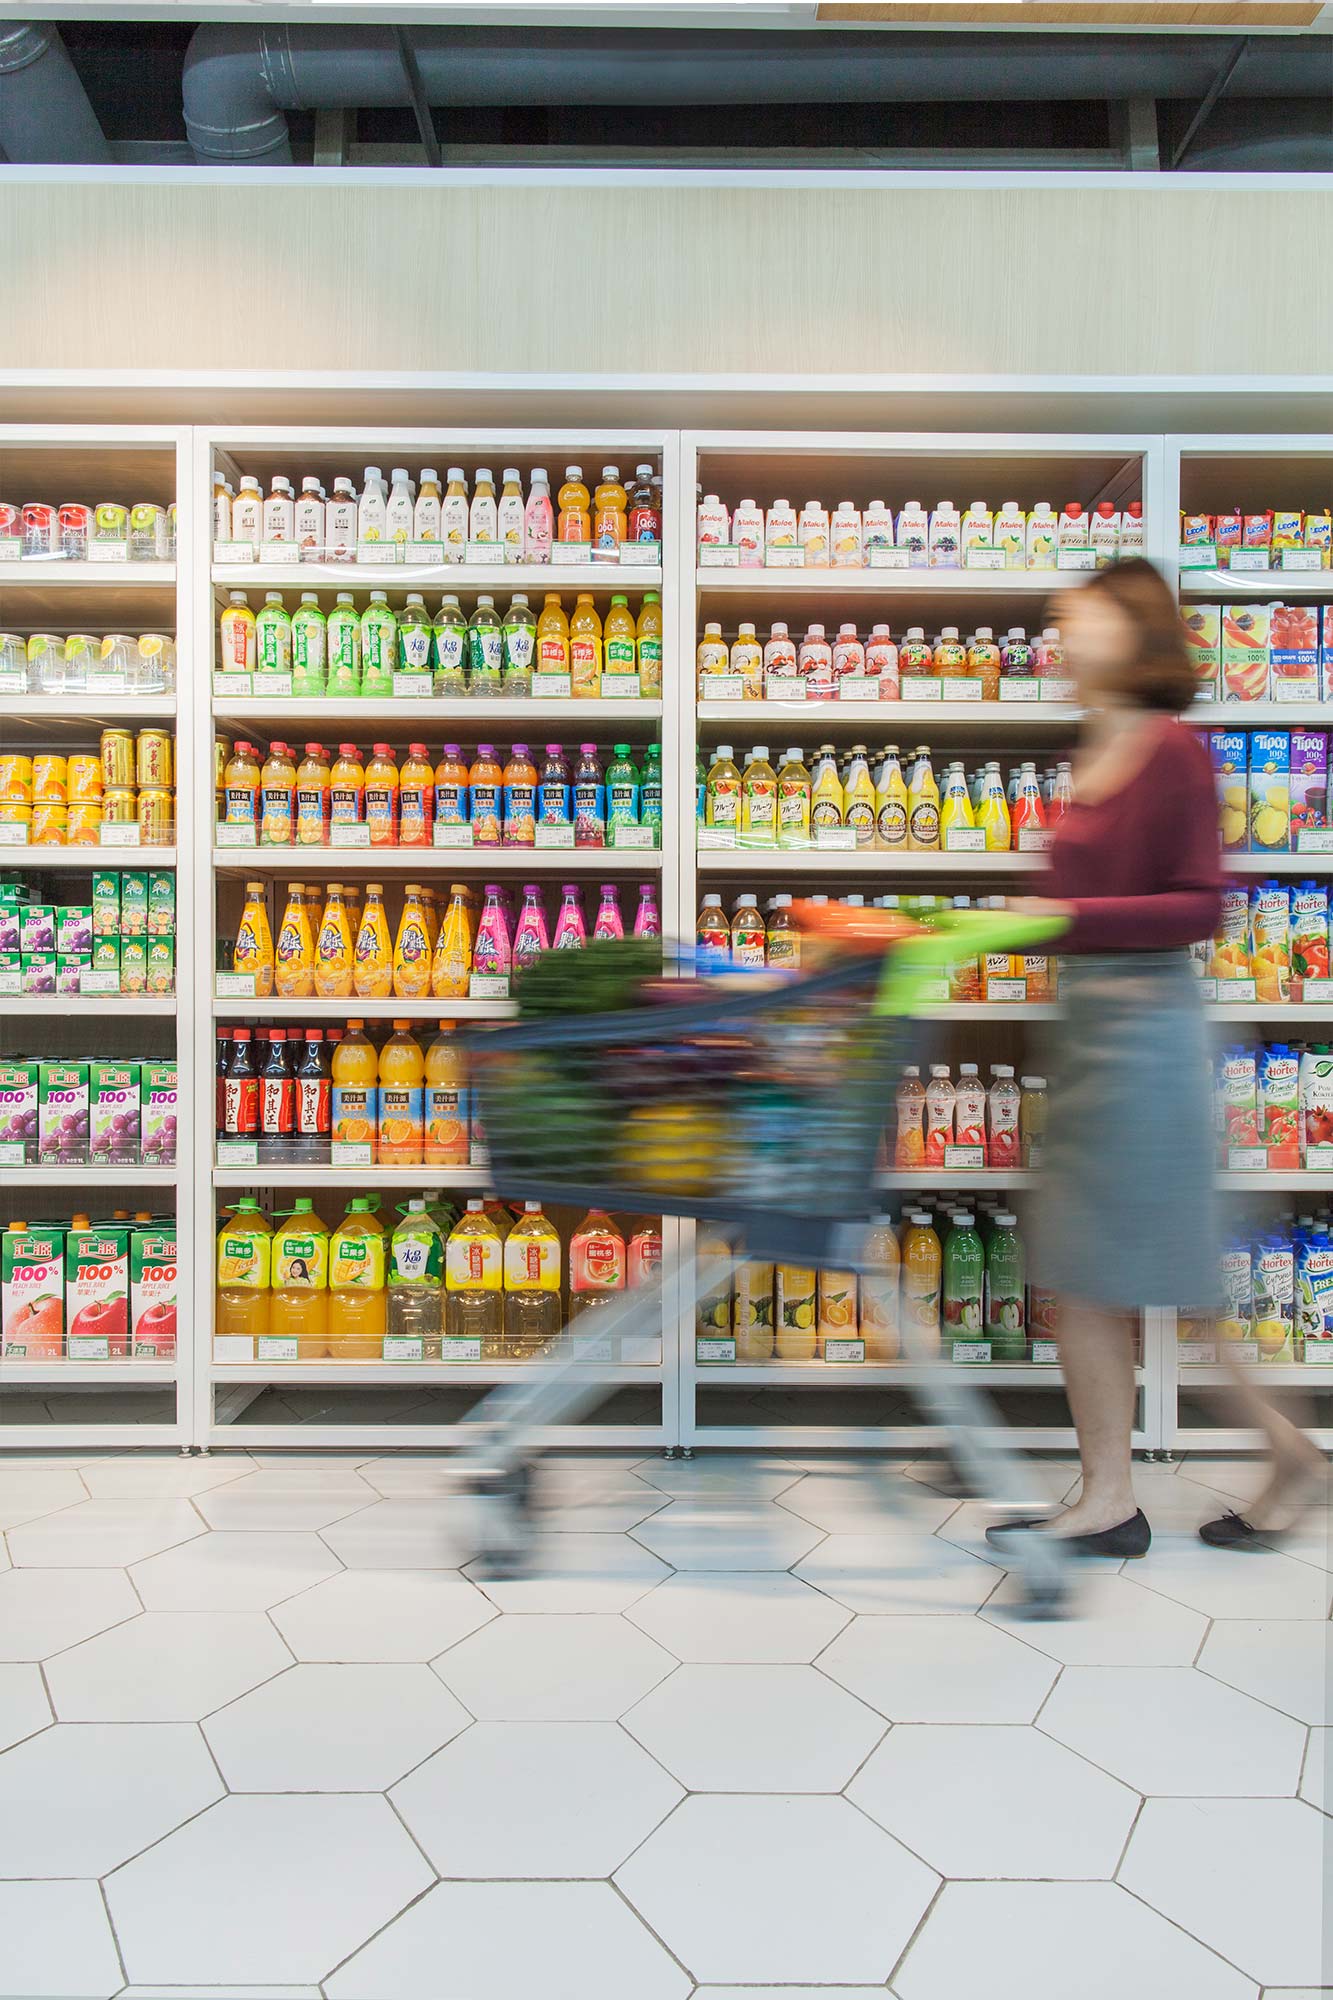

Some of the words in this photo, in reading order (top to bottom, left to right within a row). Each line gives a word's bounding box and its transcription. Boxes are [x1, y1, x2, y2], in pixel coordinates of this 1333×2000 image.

[640, 518, 657, 529] Qoo
[1277, 520, 1299, 531] LEON
[1186, 525, 1207, 536] LEON
[1219, 524, 1240, 535] LEON
[1247, 523, 1269, 535] LEON
[1310, 524, 1330, 534] LEON
[1298, 655, 1317, 663] 100%
[1211, 735, 1243, 750] Tipco
[1254, 735, 1287, 750] Tipco
[1292, 735, 1324, 751] Tipco
[714, 802, 736, 812] フルーツ
[752, 802, 772, 812] フルーツ
[782, 803, 801, 813] フルーツ
[987, 955, 1008, 966] オレンジ
[1025, 956, 1046, 966] オレンジ
[48, 1069, 79, 1086] 汇源
[99, 1069, 131, 1086] 汇源
[48, 1091, 85, 1103] 100%
[99, 1091, 136, 1103] 100%
[344, 1094, 364, 1102] 美汁源
[436, 1095, 455, 1103] 美汁源
[226, 1083, 239, 1125] 和其正
[266, 1083, 279, 1126] 和其正
[303, 1083, 317, 1126] 和其正
[13, 1239, 52, 1259] 汇源
[79, 1239, 118, 1259] 汇源
[226, 1247, 252, 1255] 芒果多
[286, 1246, 312, 1254] 芒果多
[342, 1248, 364, 1257] 芒果多
[589, 1249, 612, 1257] 蜜桃多
[643, 1249, 661, 1257] 蜜桃
[869, 1251, 891, 1260] URE
[910, 1252, 939, 1262] PURE
[953, 1253, 981, 1262] PURE
[991, 1254, 1018, 1262] PURE
[1262, 1259, 1293, 1269] Hortex
[1308, 1259, 1333, 1269] Horte
[13, 1266, 58, 1281] 100%
[78, 1265, 123, 1281] 100%
[112, 1347, 122, 1355] 2L
